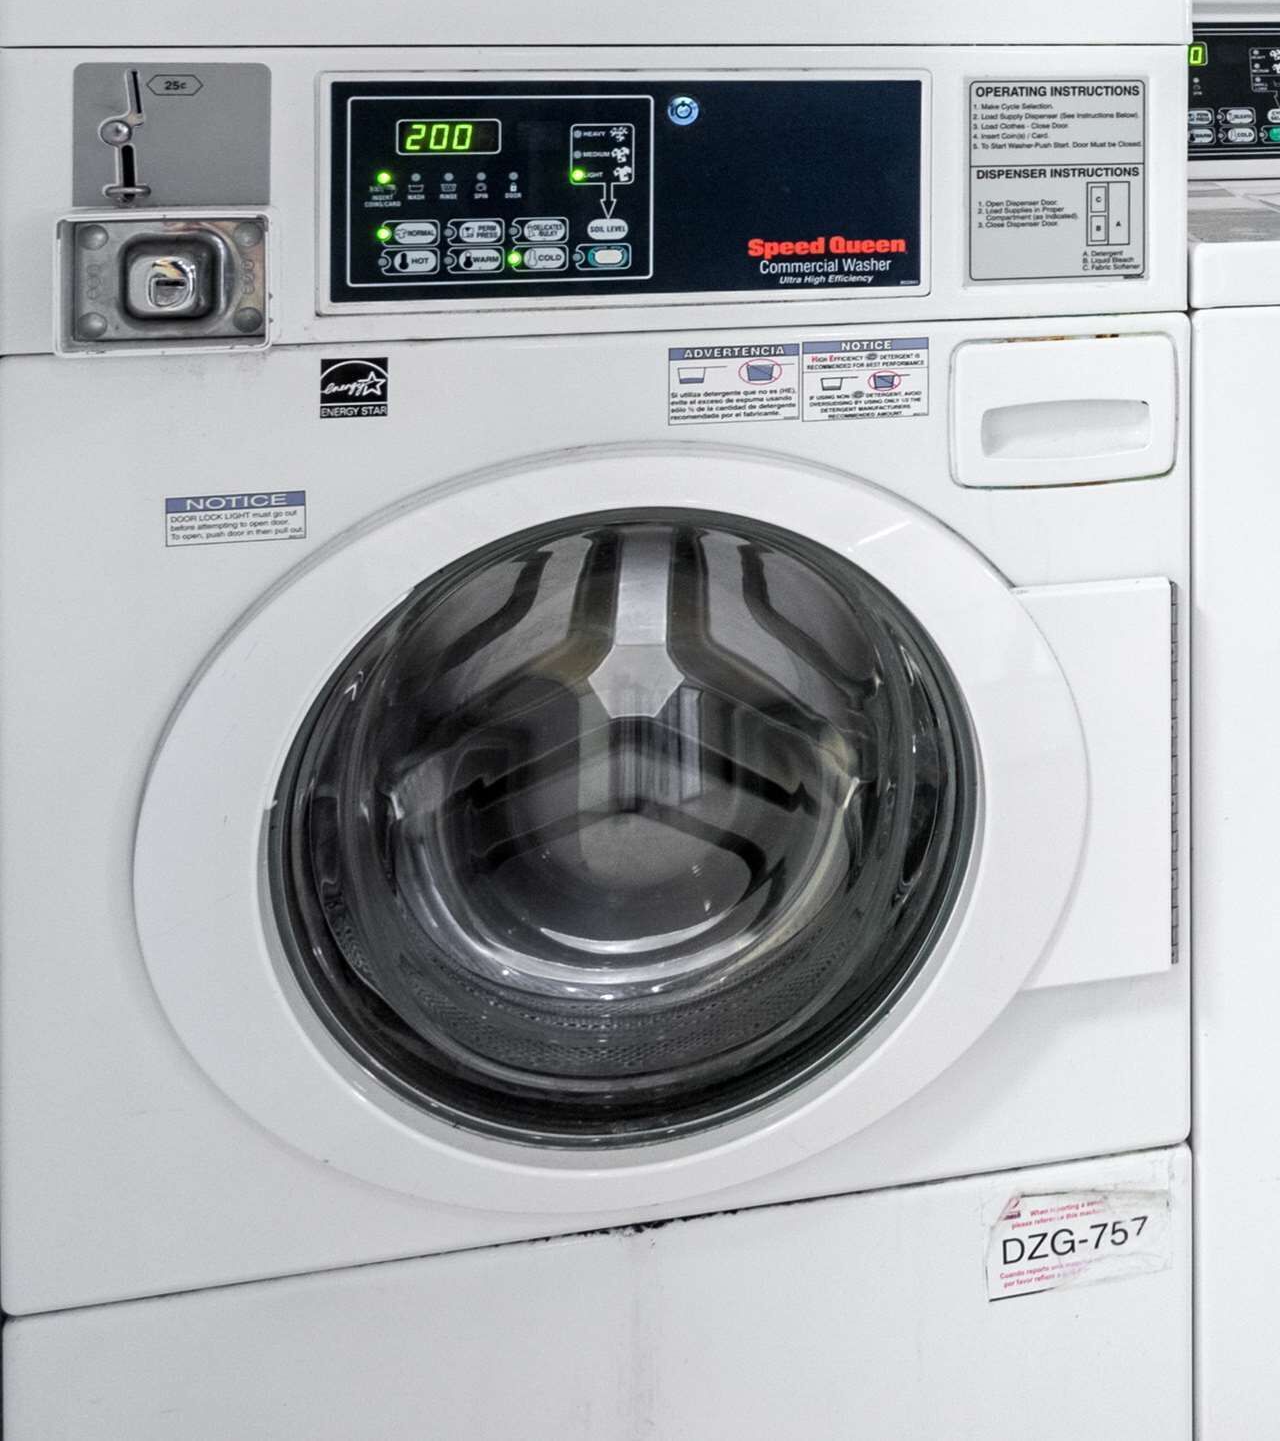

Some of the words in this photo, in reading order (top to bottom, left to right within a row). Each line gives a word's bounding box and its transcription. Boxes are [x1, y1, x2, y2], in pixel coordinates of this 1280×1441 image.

[975, 86, 1047, 97] OPERATING
[1050, 85, 1140, 96] INSTRUCTIONS
[1001, 103, 1020, 111] Cycle
[1000, 113, 1022, 121] Supply
[1025, 113, 1058, 121] Dispenser
[405, 124, 472, 150] 200
[977, 168, 1047, 179] DISPENSER
[1050, 167, 1140, 178] INSTRUCTIONS
[986, 200, 1004, 208] Open
[986, 214, 1032, 222] Compartment
[748, 236, 825, 260] Speed
[829, 236, 906, 253] Queen
[1091, 250, 1123, 258] Detergent
[759, 259, 838, 274] Commercial
[842, 258, 892, 272] Washer
[1091, 257, 1111, 265] Liquid
[779, 275, 801, 285] Ultra
[804, 275, 826, 285] High
[828, 274, 873, 283] Efficiency
[841, 341, 892, 351] NOTICE
[684, 346, 785, 358] ADVERTENCIA
[321, 407, 359, 417] ENERGY
[361, 406, 387, 415] STAR
[186, 494, 287, 510] NOTICE
[170, 515, 197, 523] DOOR
[200, 514, 223, 522] LOCK
[225, 512, 250, 520] LIGHT
[170, 524, 195, 532] before
[197, 522, 239, 530] attempting
[206, 531, 225, 539] push
[1002, 1215, 1148, 1265] DZG-757
